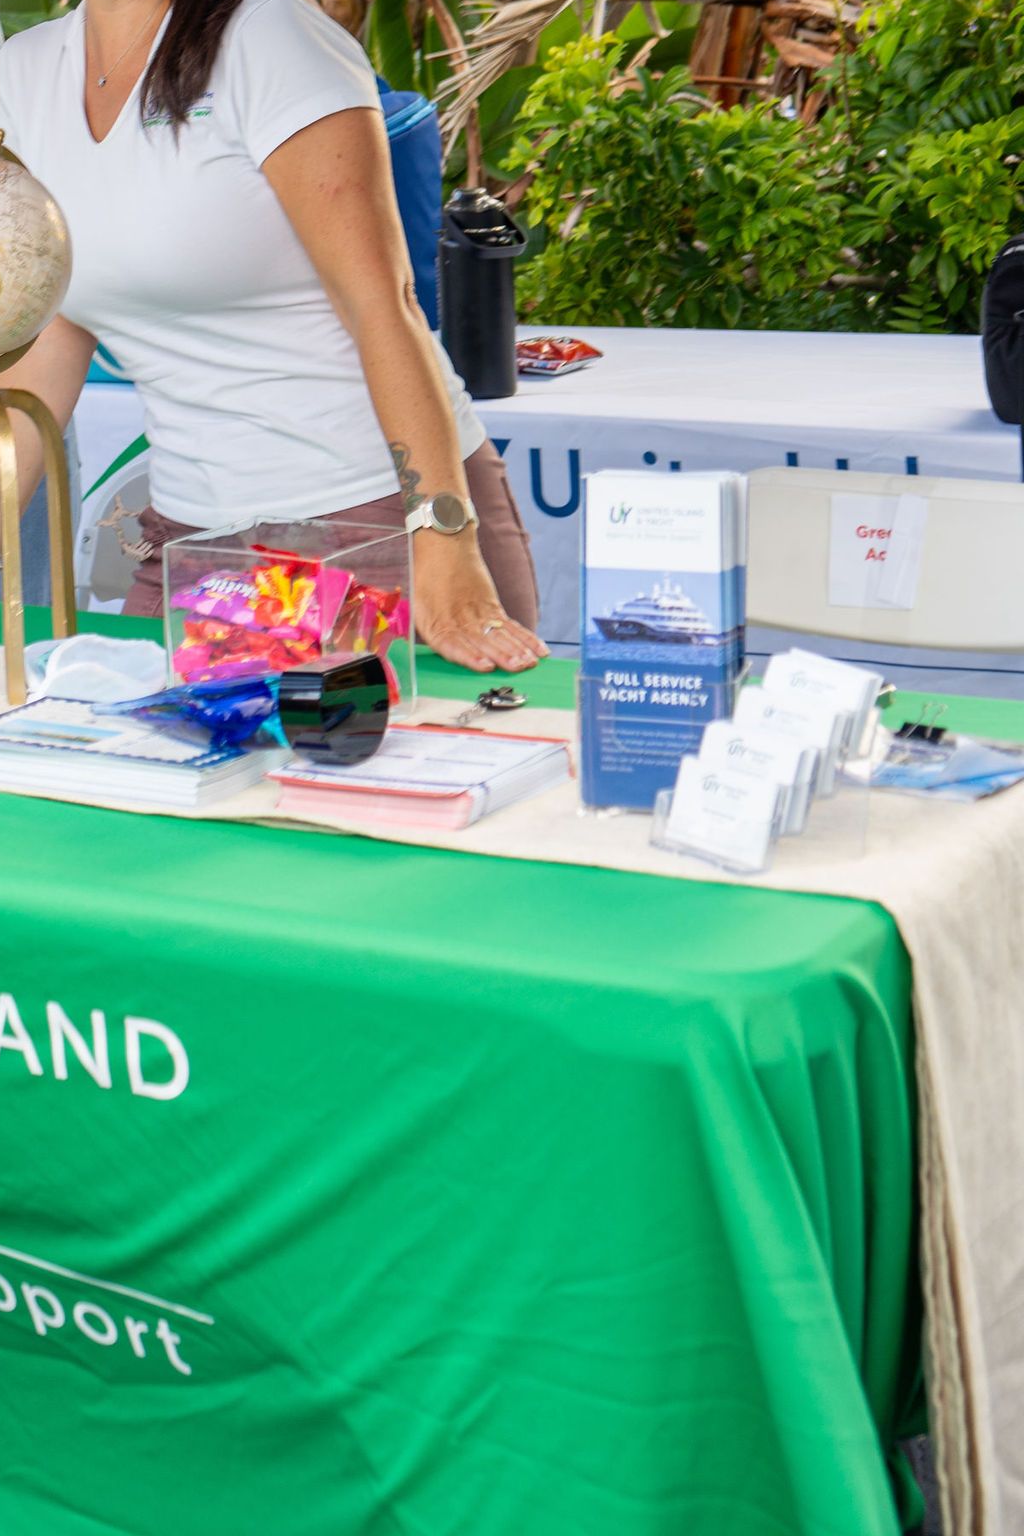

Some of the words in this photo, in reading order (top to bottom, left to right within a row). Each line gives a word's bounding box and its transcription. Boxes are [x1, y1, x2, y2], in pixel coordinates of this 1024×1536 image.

[604, 671, 640, 687] FULL
[643, 673, 703, 690] SERVICE
[599, 687, 647, 704] YACHT
[650, 690, 709, 708] AGENCY
